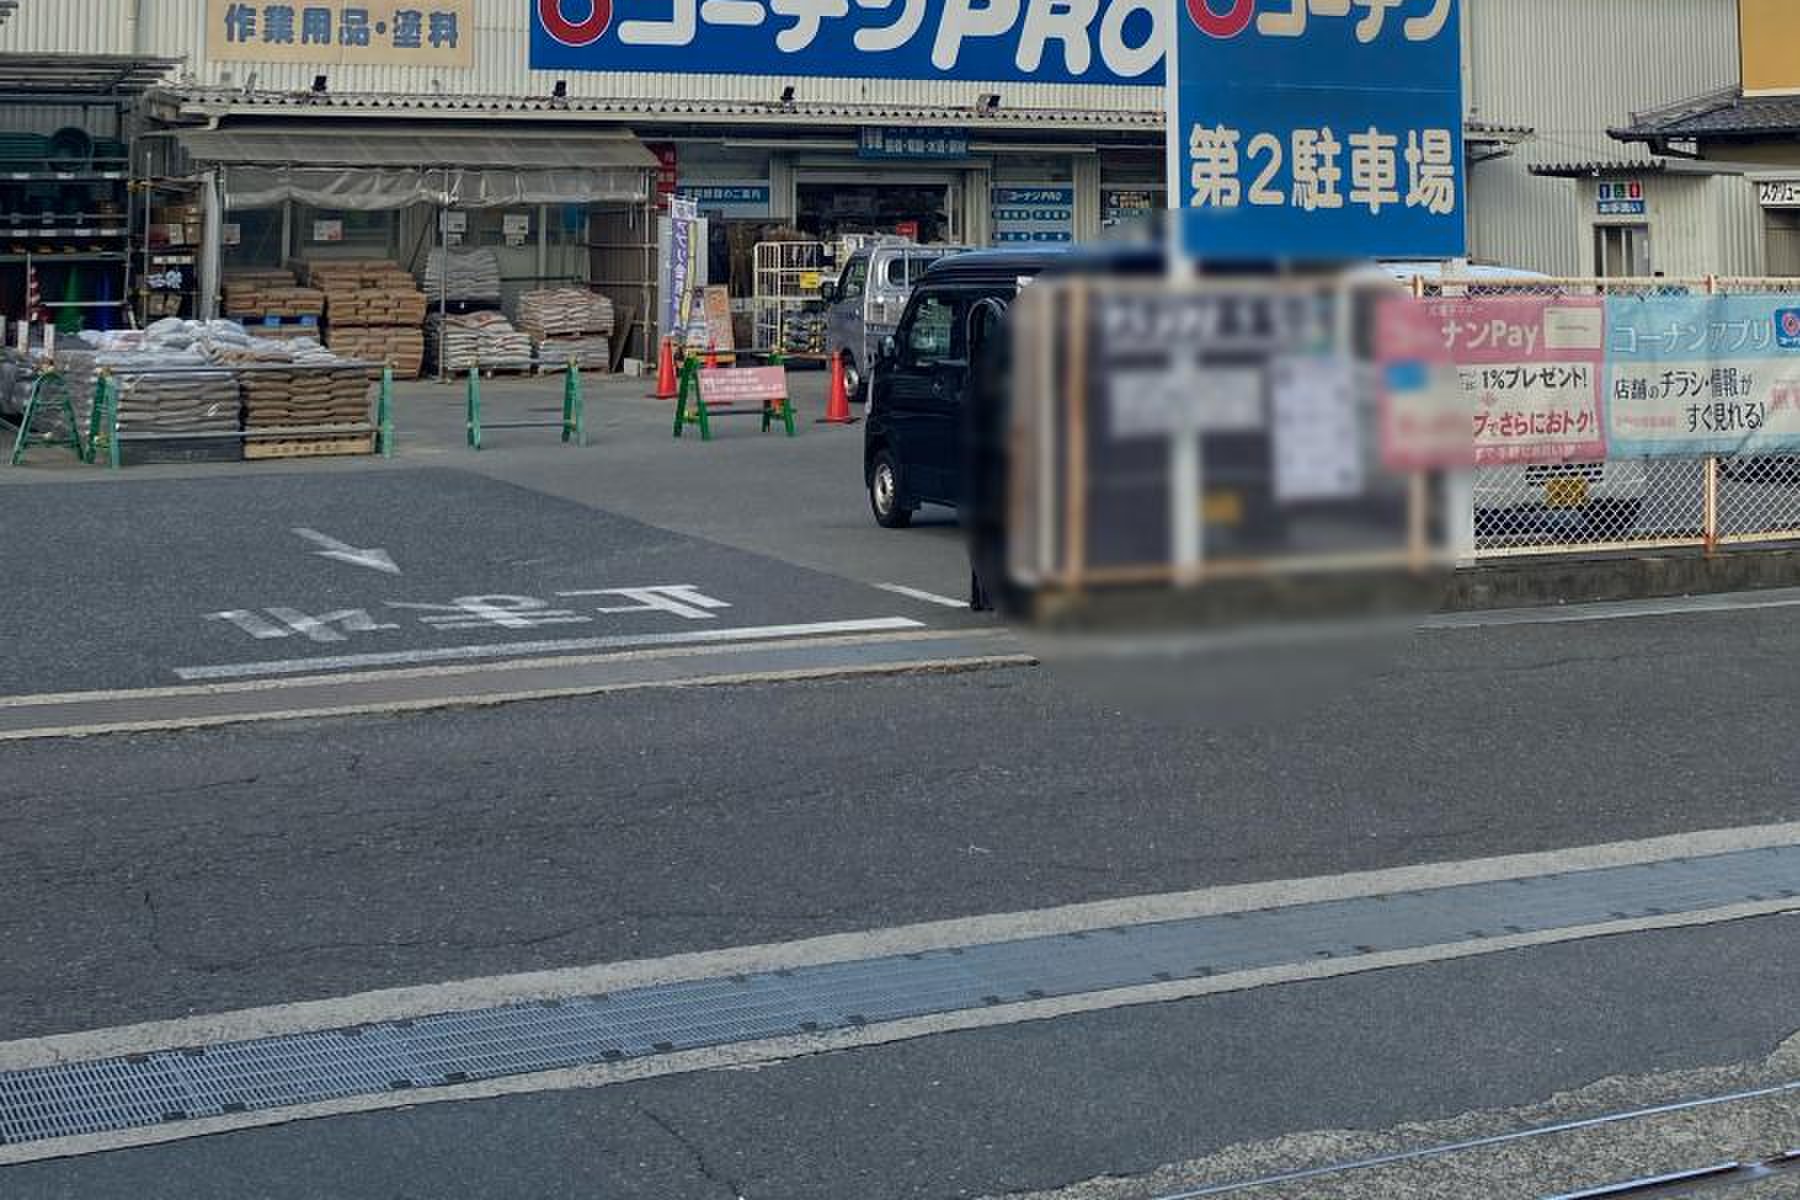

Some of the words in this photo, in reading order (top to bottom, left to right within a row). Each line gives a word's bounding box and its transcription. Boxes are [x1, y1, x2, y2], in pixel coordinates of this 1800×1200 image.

[223, 3, 459, 49] 作業用品・塗料
[1188, 124, 1456, 216] 第2駐車場
[1614, 319, 1770, 353] コーナンアプリ
